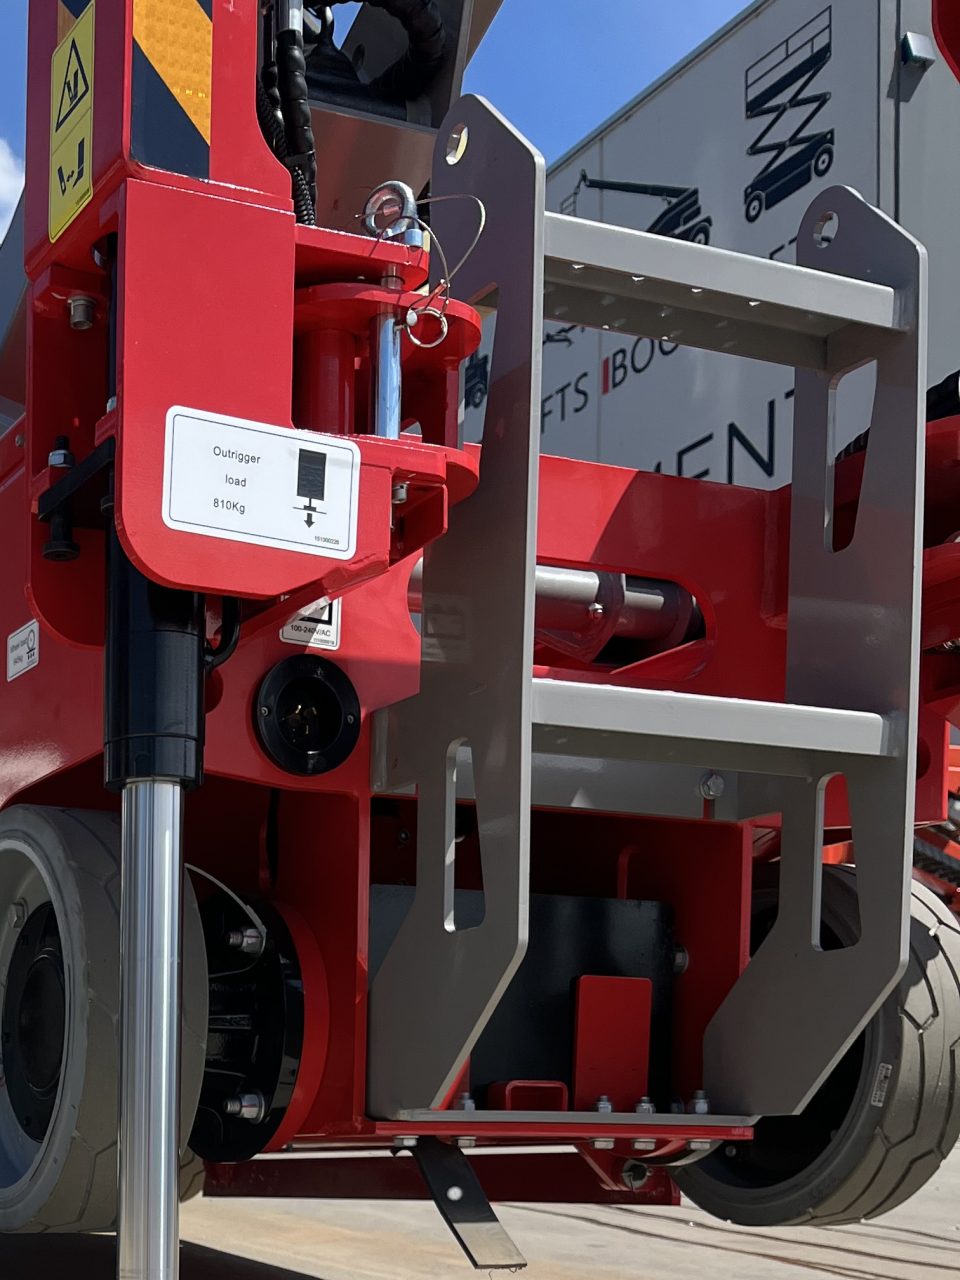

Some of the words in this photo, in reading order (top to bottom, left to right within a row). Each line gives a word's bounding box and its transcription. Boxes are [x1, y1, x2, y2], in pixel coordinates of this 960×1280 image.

[541, 372, 588, 433] FTS
[611, 337, 679, 389] BO
[213, 446, 261, 464] Outrigger
[225, 474, 247, 487] load
[213, 498, 245, 515] 810Kg
